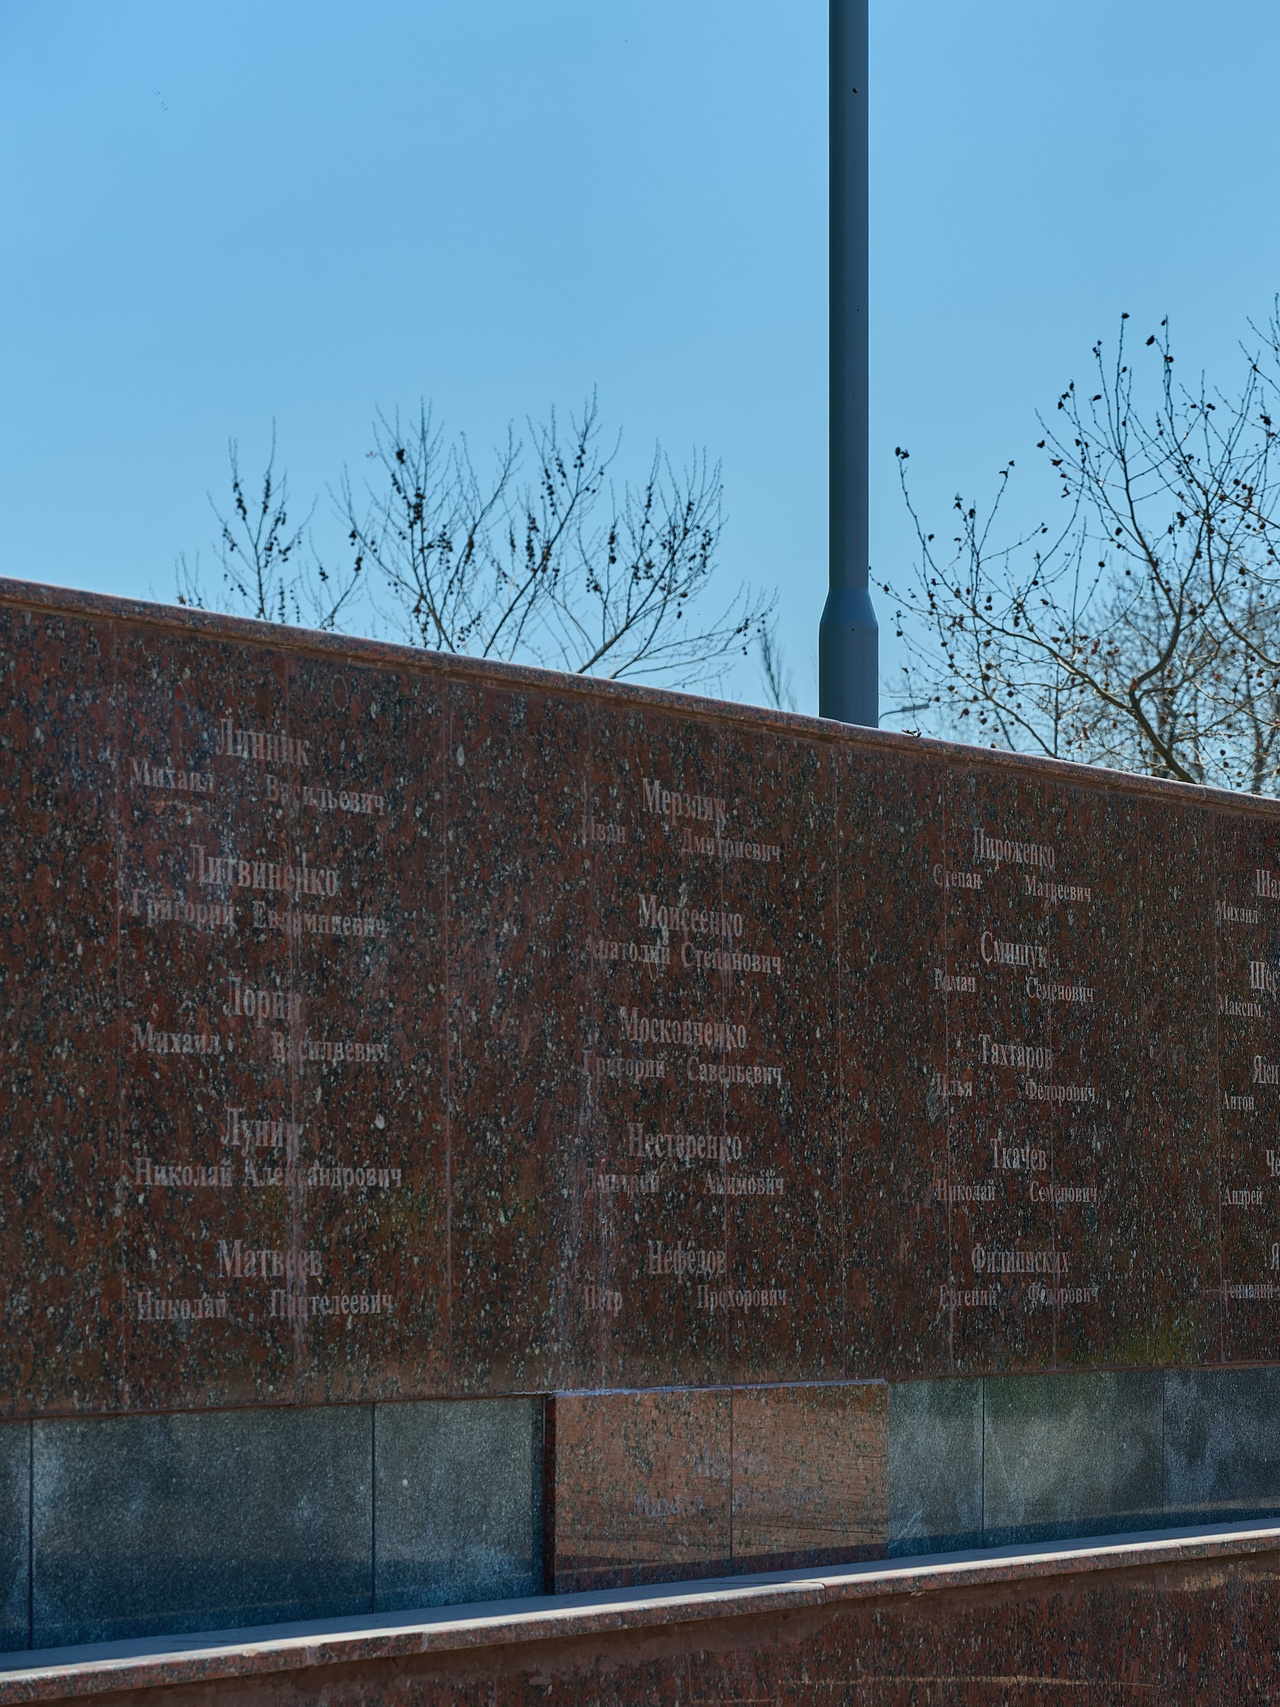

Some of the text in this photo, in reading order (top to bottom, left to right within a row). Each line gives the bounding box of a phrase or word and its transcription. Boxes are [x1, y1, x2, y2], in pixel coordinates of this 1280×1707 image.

[186, 844, 340, 898] Литвиненко
[933, 863, 982, 890] Степан
[680, 941, 782, 974] Степанович
[134, 1156, 233, 1187] Николай
[137, 1289, 227, 1320] Николай
